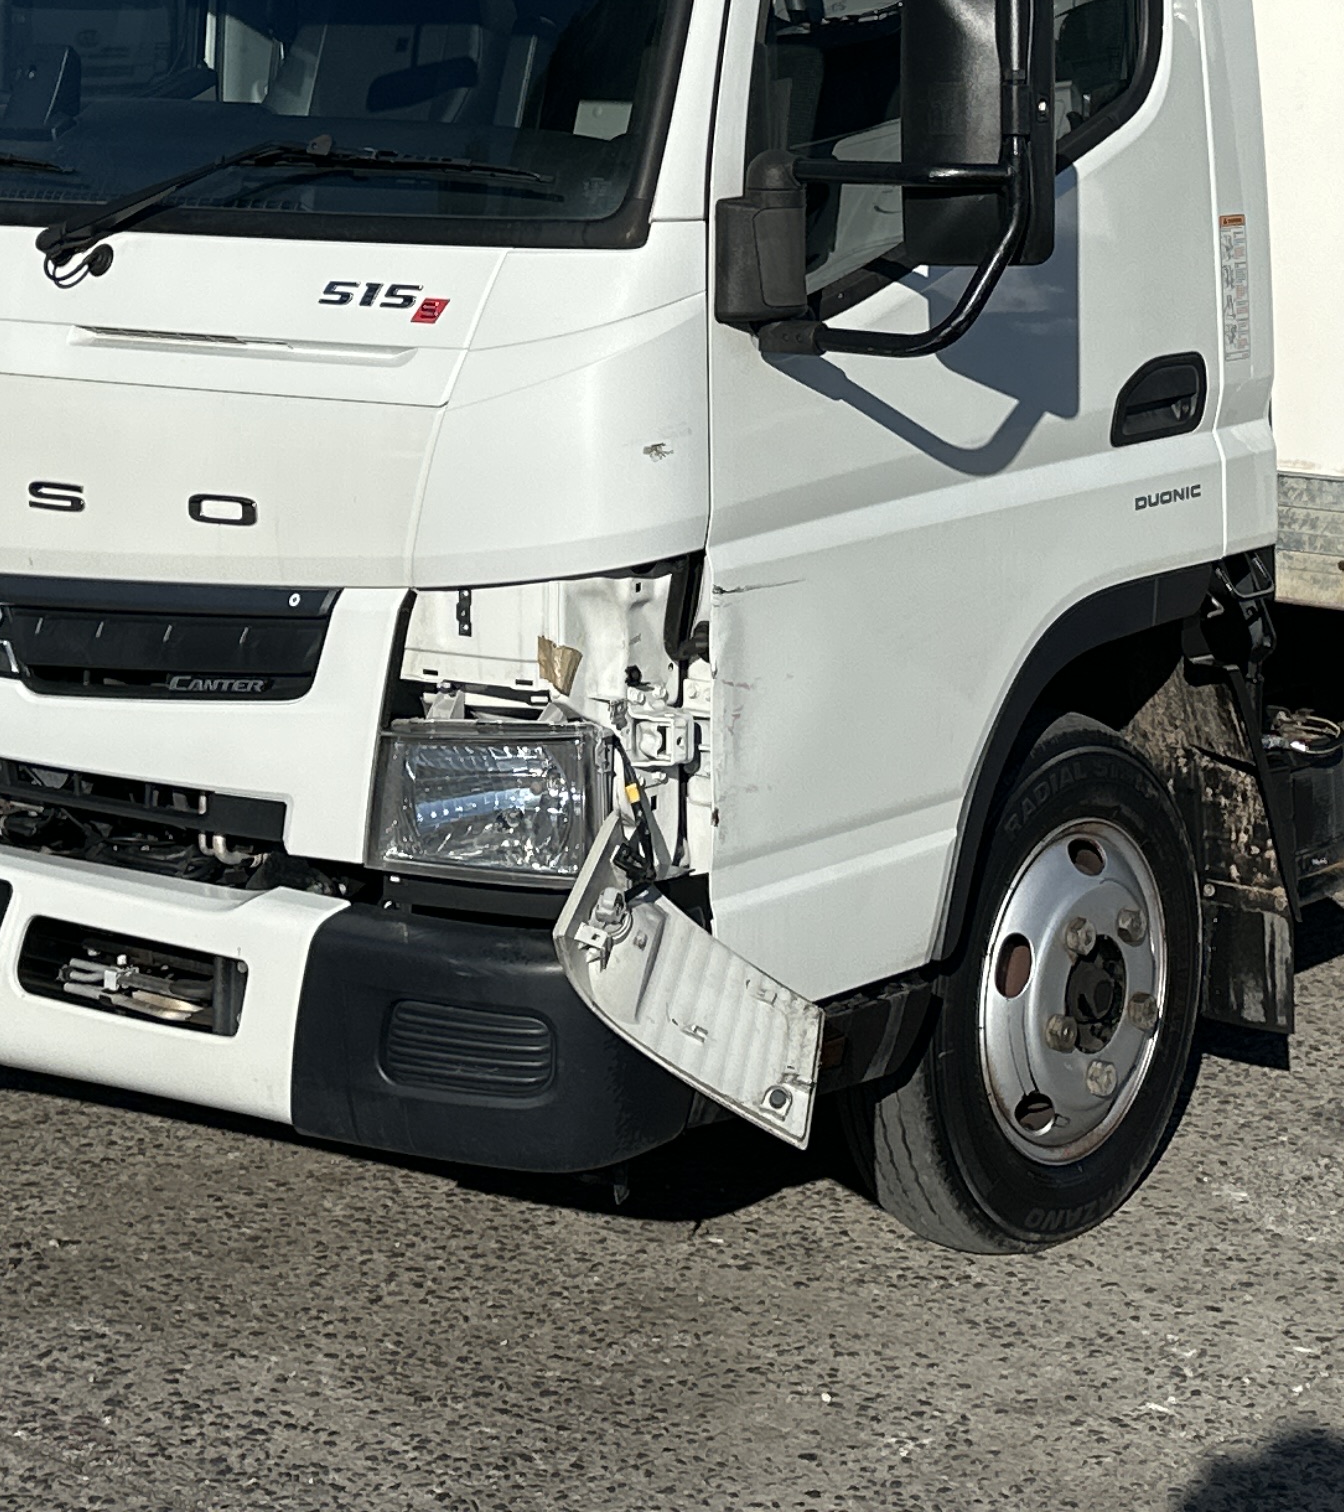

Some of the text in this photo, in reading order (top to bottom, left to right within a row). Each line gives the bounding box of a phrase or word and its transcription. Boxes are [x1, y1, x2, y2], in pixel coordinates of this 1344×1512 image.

[1134, 484, 1202, 511] DUONIC
[168, 675, 264, 693] CANTER
[1003, 761, 1089, 840] RADIAL
